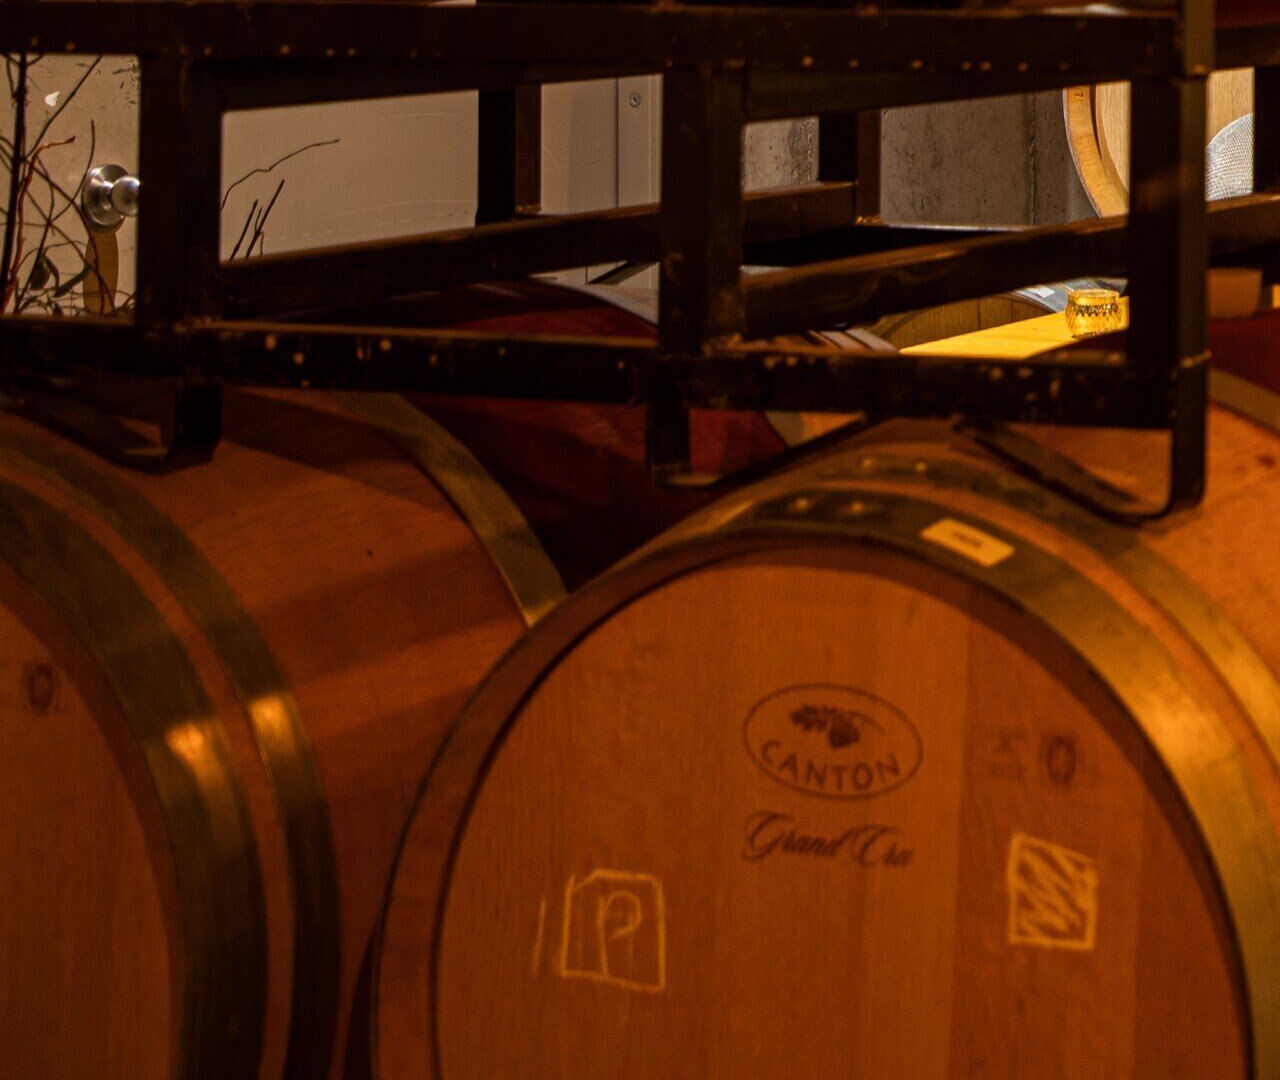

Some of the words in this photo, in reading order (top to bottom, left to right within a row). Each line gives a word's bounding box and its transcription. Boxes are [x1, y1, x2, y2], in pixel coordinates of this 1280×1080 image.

[761, 739, 901, 792] CANTON
[742, 810, 851, 864] Grand
[597, 890, 643, 978] P
